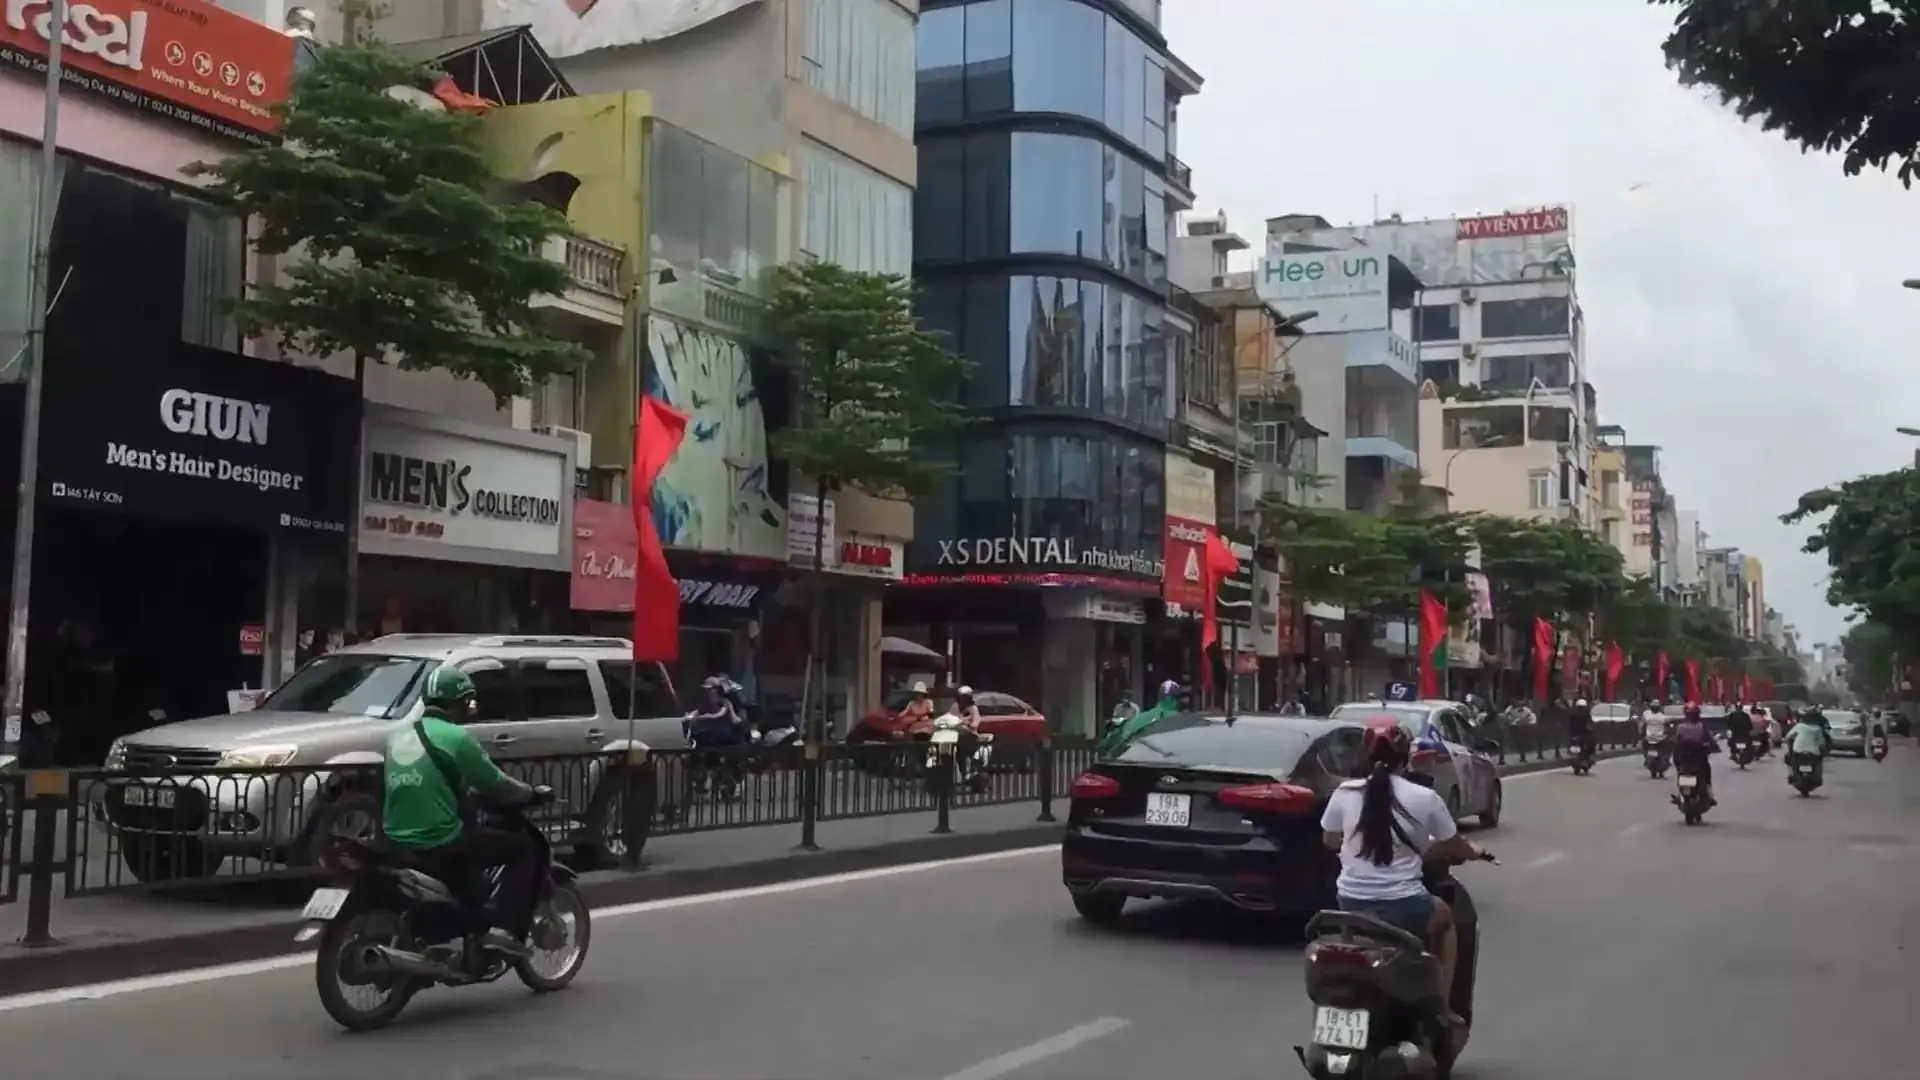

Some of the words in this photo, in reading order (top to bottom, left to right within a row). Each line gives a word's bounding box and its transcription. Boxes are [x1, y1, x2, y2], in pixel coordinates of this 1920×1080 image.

[151, 66, 186, 89] Where
[187, 80, 210, 97] Your
[211, 88, 239, 107] Voice
[160, 388, 271, 446] GIUN
[106, 442, 167, 472] Men's
[168, 451, 215, 478] Hair
[217, 459, 303, 492] Designer
[370, 451, 472, 512] MEN'S
[475, 488, 559, 523] COLLECTION
[938, 539, 969, 565] XS
[976, 537, 1077, 564] DENTAL
